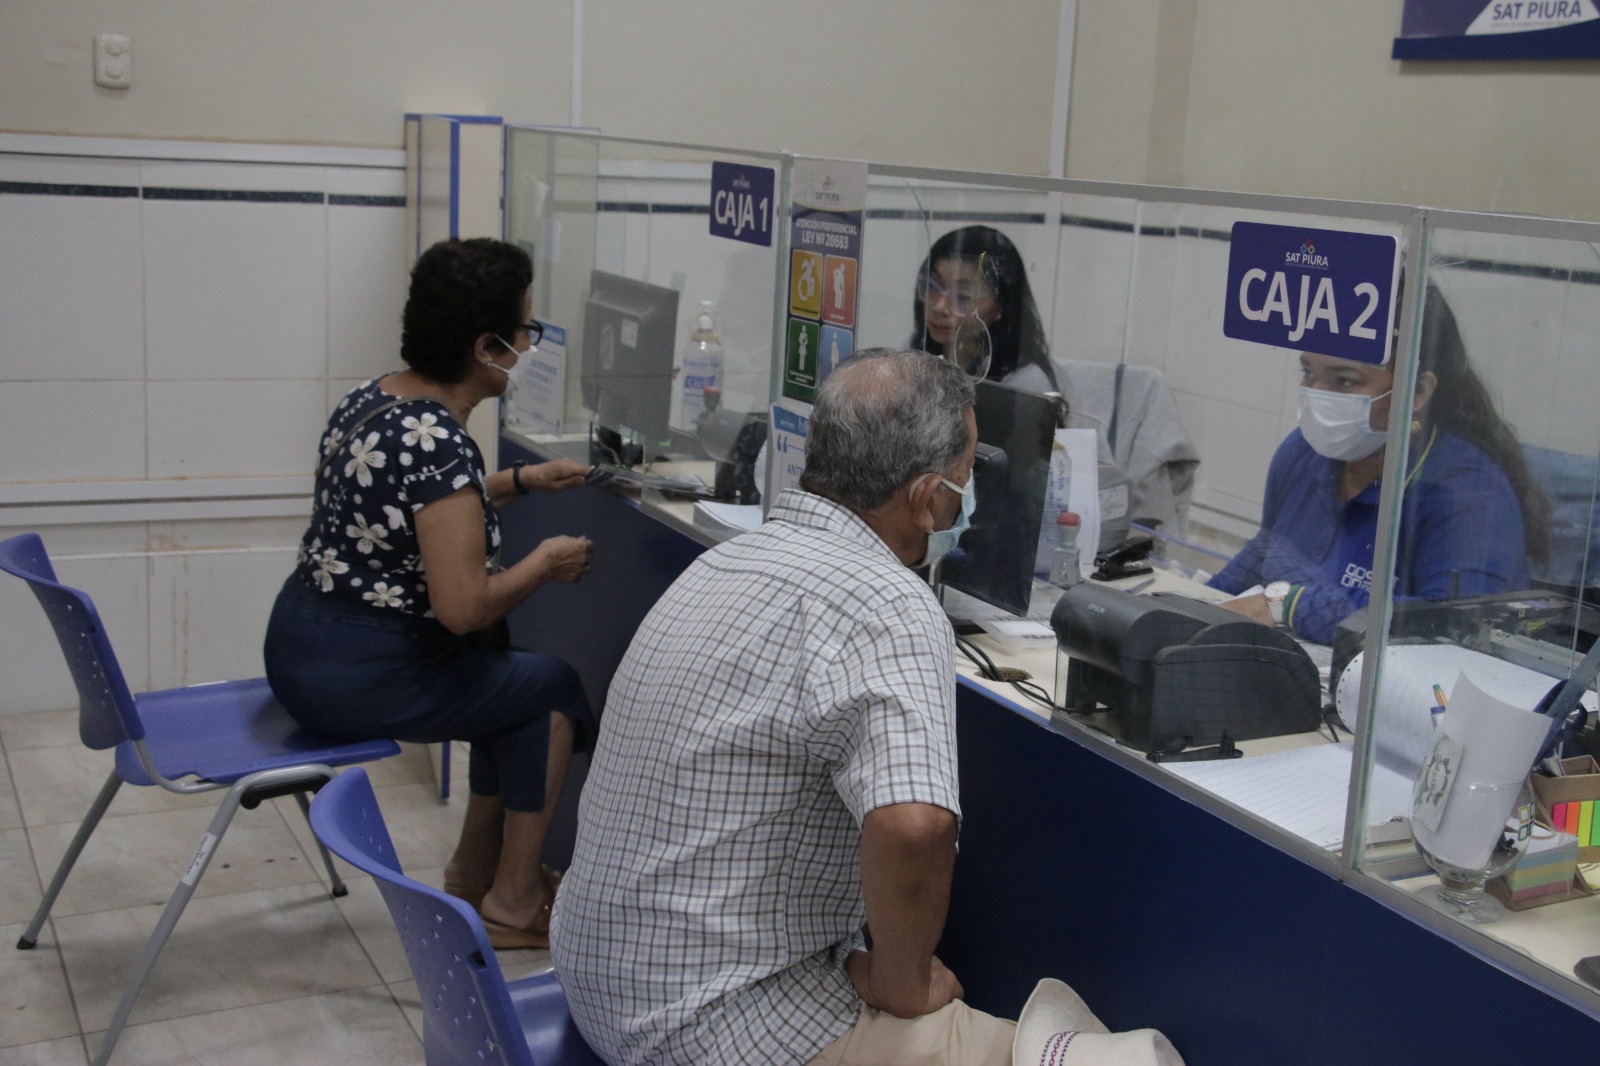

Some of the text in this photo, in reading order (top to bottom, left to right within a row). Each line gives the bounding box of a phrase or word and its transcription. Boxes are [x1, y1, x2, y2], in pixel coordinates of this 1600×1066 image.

[1492, 0, 1581, 20] SAT PIURA
[714, 189, 768, 237] CAJA 1
[819, 221, 857, 236] PREFERENCIAL
[802, 230, 815, 244] LEY
[825, 234, 849, 250] 28683
[1285, 251, 1301, 263] SAT
[1302, 253, 1329, 267] PIURA
[1239, 267, 1379, 342] CAJA 2
